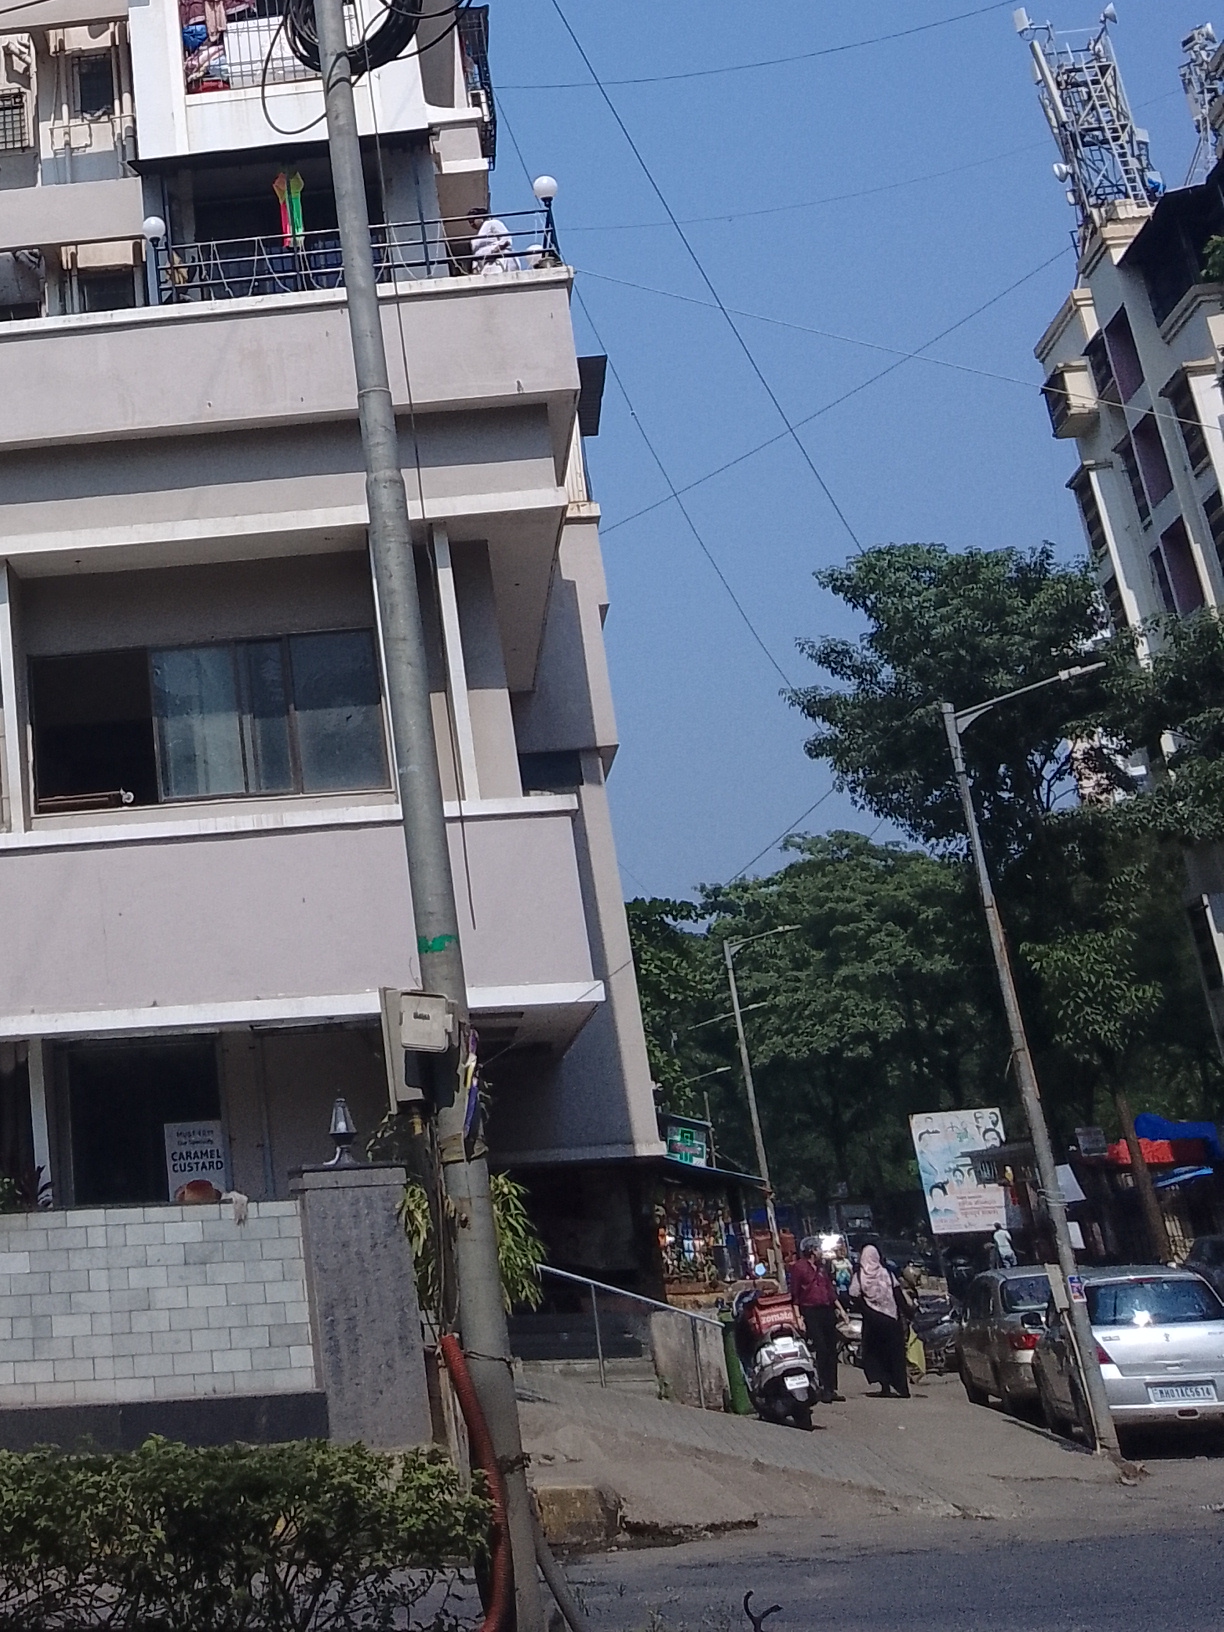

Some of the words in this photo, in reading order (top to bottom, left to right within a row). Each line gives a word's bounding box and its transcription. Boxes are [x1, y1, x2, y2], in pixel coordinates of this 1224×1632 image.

[171, 1149, 221, 1161] CARAMEL
[172, 1161, 223, 1172] CUSTARD
[760, 1311, 794, 1325] zomato
